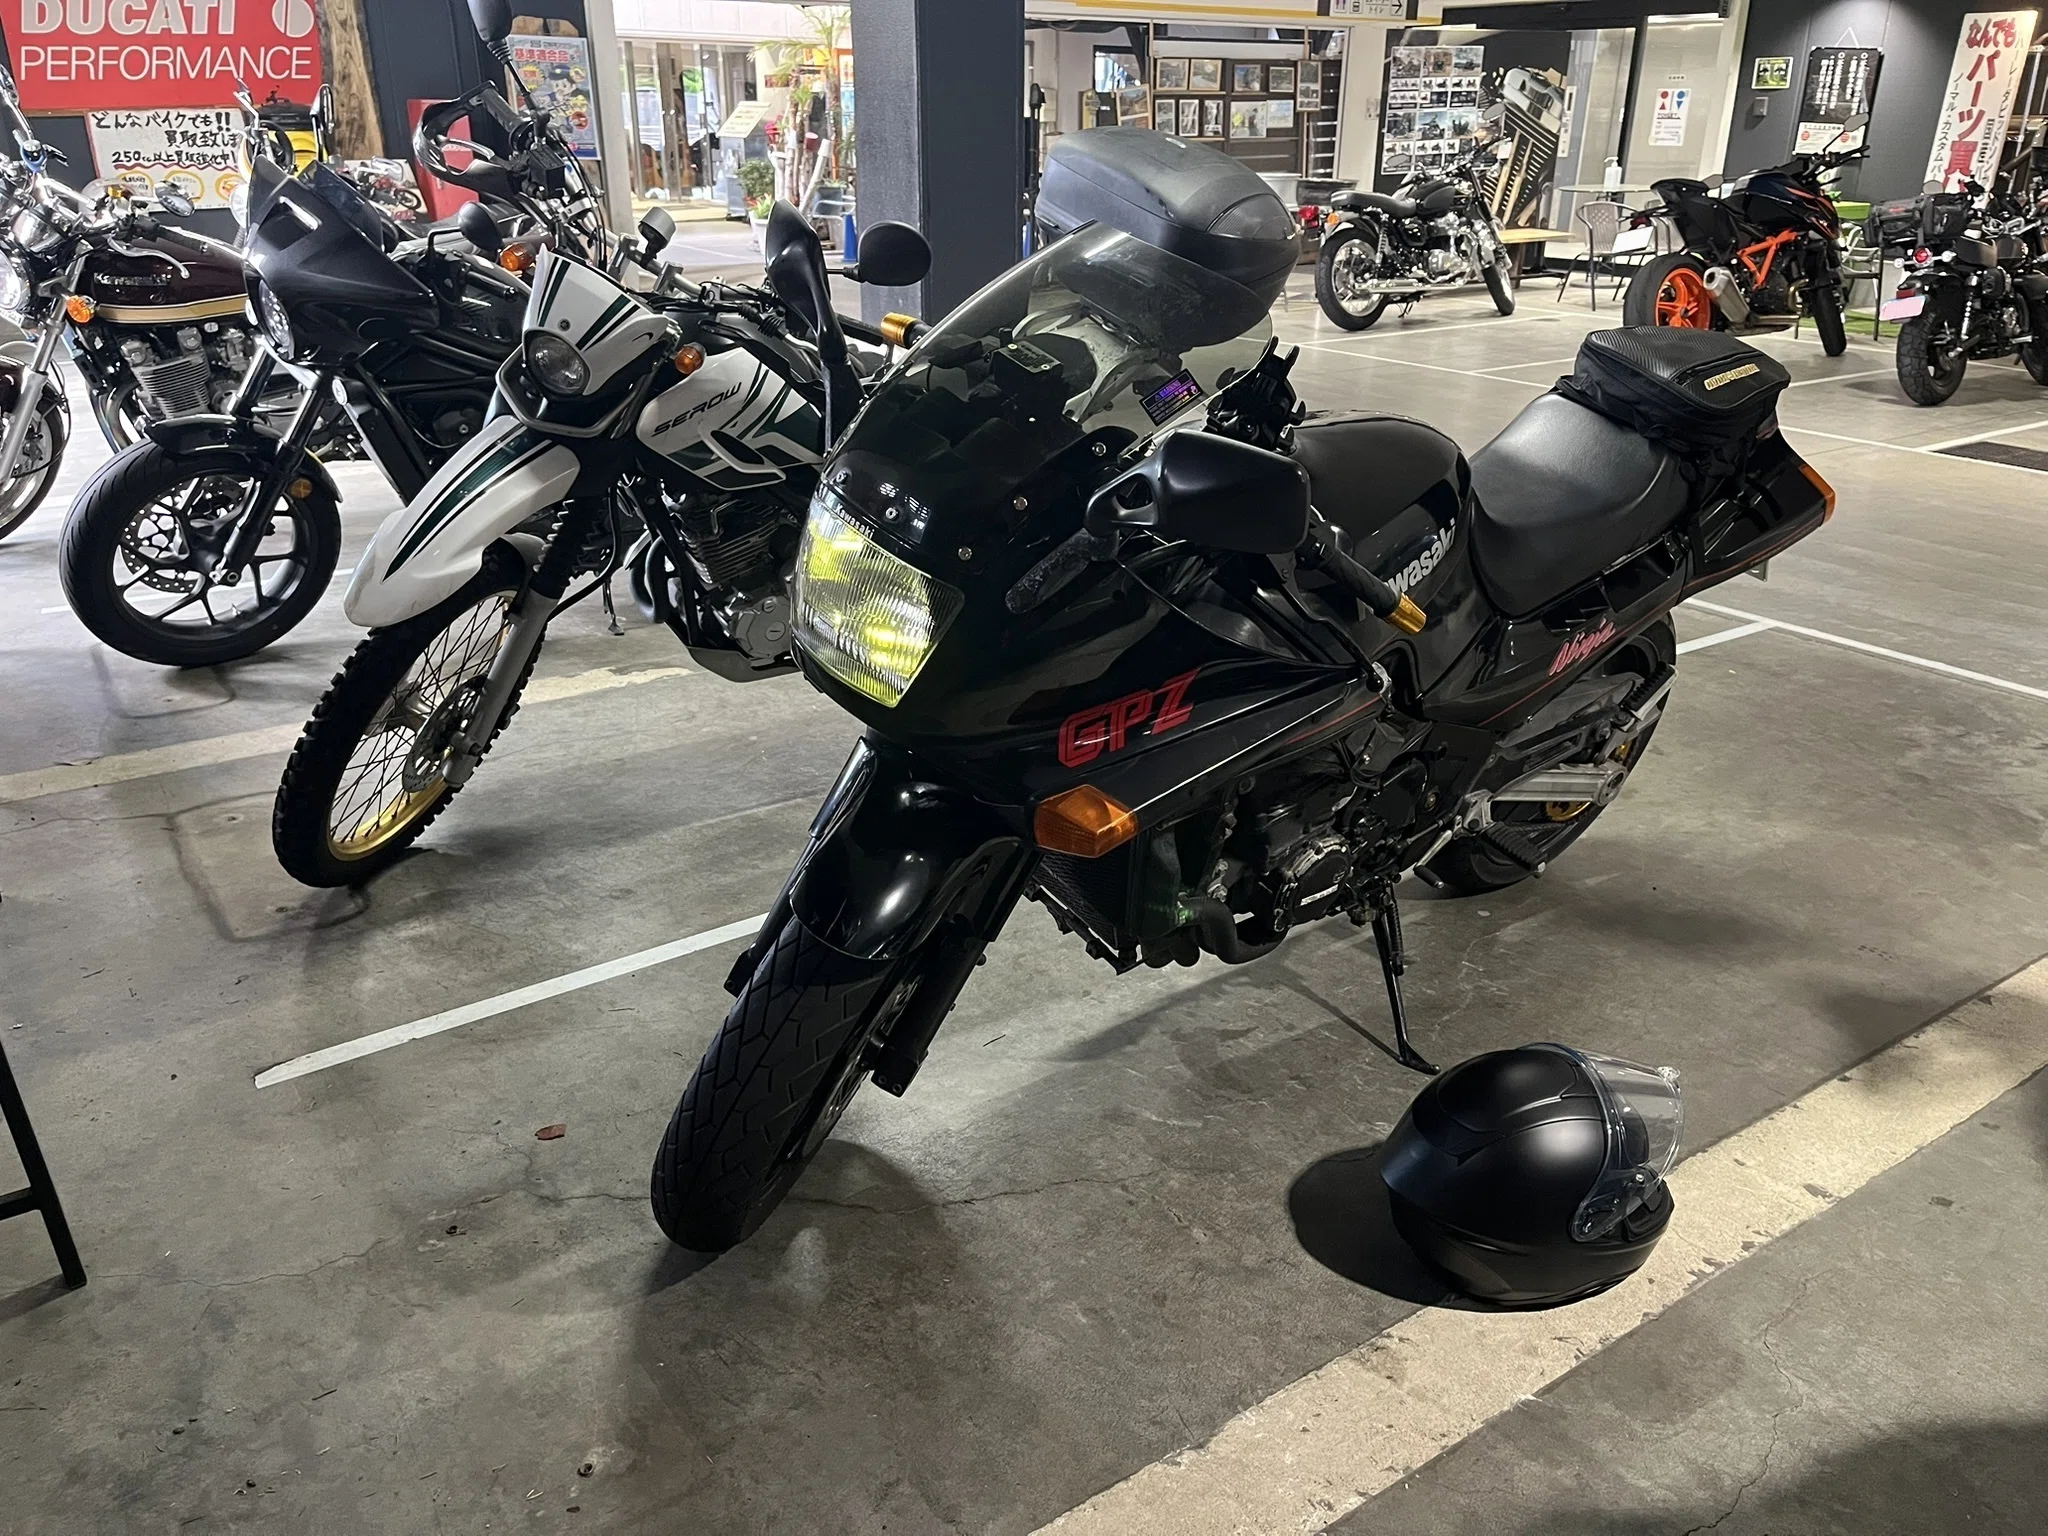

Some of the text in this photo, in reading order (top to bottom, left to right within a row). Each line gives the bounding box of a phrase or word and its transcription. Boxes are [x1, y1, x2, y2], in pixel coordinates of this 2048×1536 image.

[21, 0, 236, 35] DUCATI
[1966, 17, 2016, 48] なんでも
[20, 45, 313, 80] PERFORMANCE
[651, 382, 743, 437] SEROW
[835, 502, 876, 540] Kawasaki
[1386, 516, 1457, 600] wasaki
[1548, 614, 1617, 677] Ninja
[1057, 667, 1201, 768] GPZ
